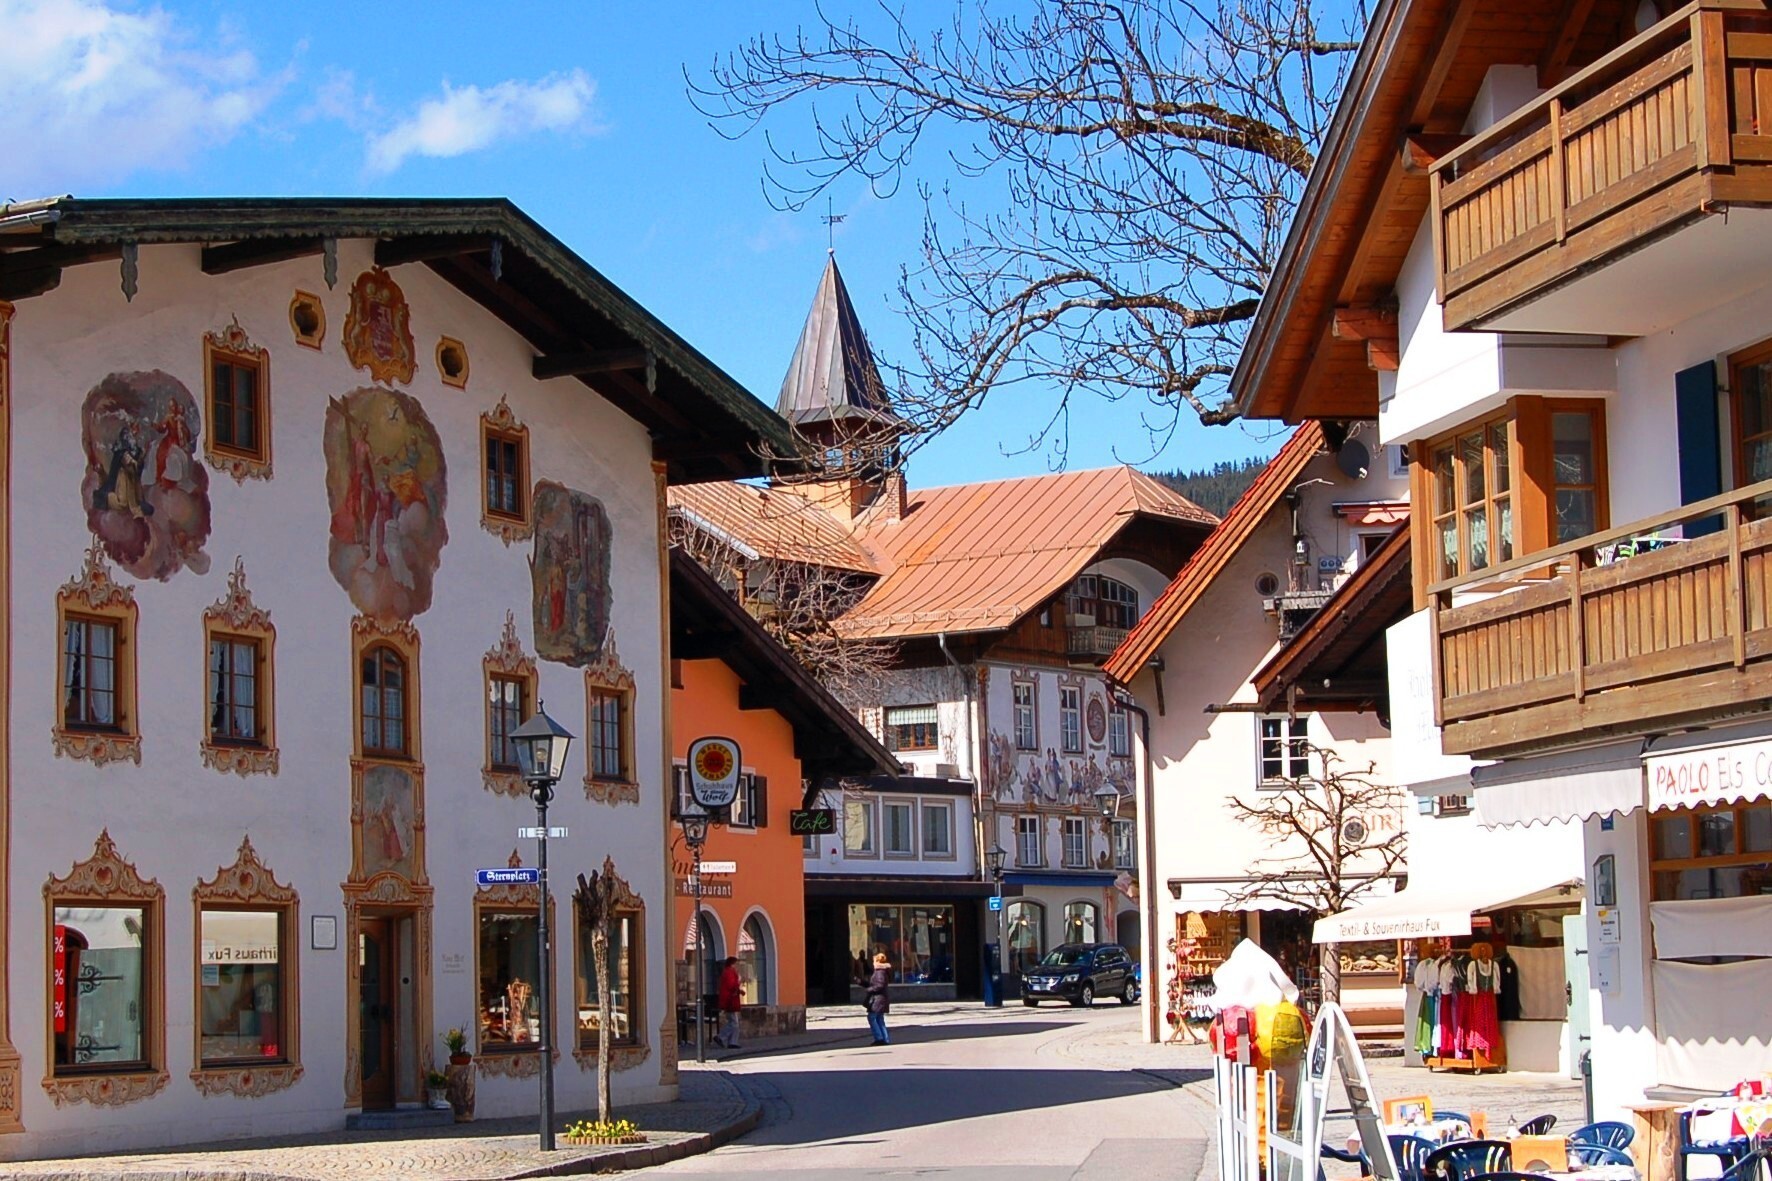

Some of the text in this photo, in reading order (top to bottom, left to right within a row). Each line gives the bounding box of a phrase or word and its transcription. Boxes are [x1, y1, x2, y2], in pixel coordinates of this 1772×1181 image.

[1657, 761, 1709, 797] PAOLO
[486, 870, 530, 882] Sternplatz
[1363, 922, 1370, 936] &
[1372, 919, 1423, 935] Souvenirhaus
[1425, 918, 1440, 931] Fux
